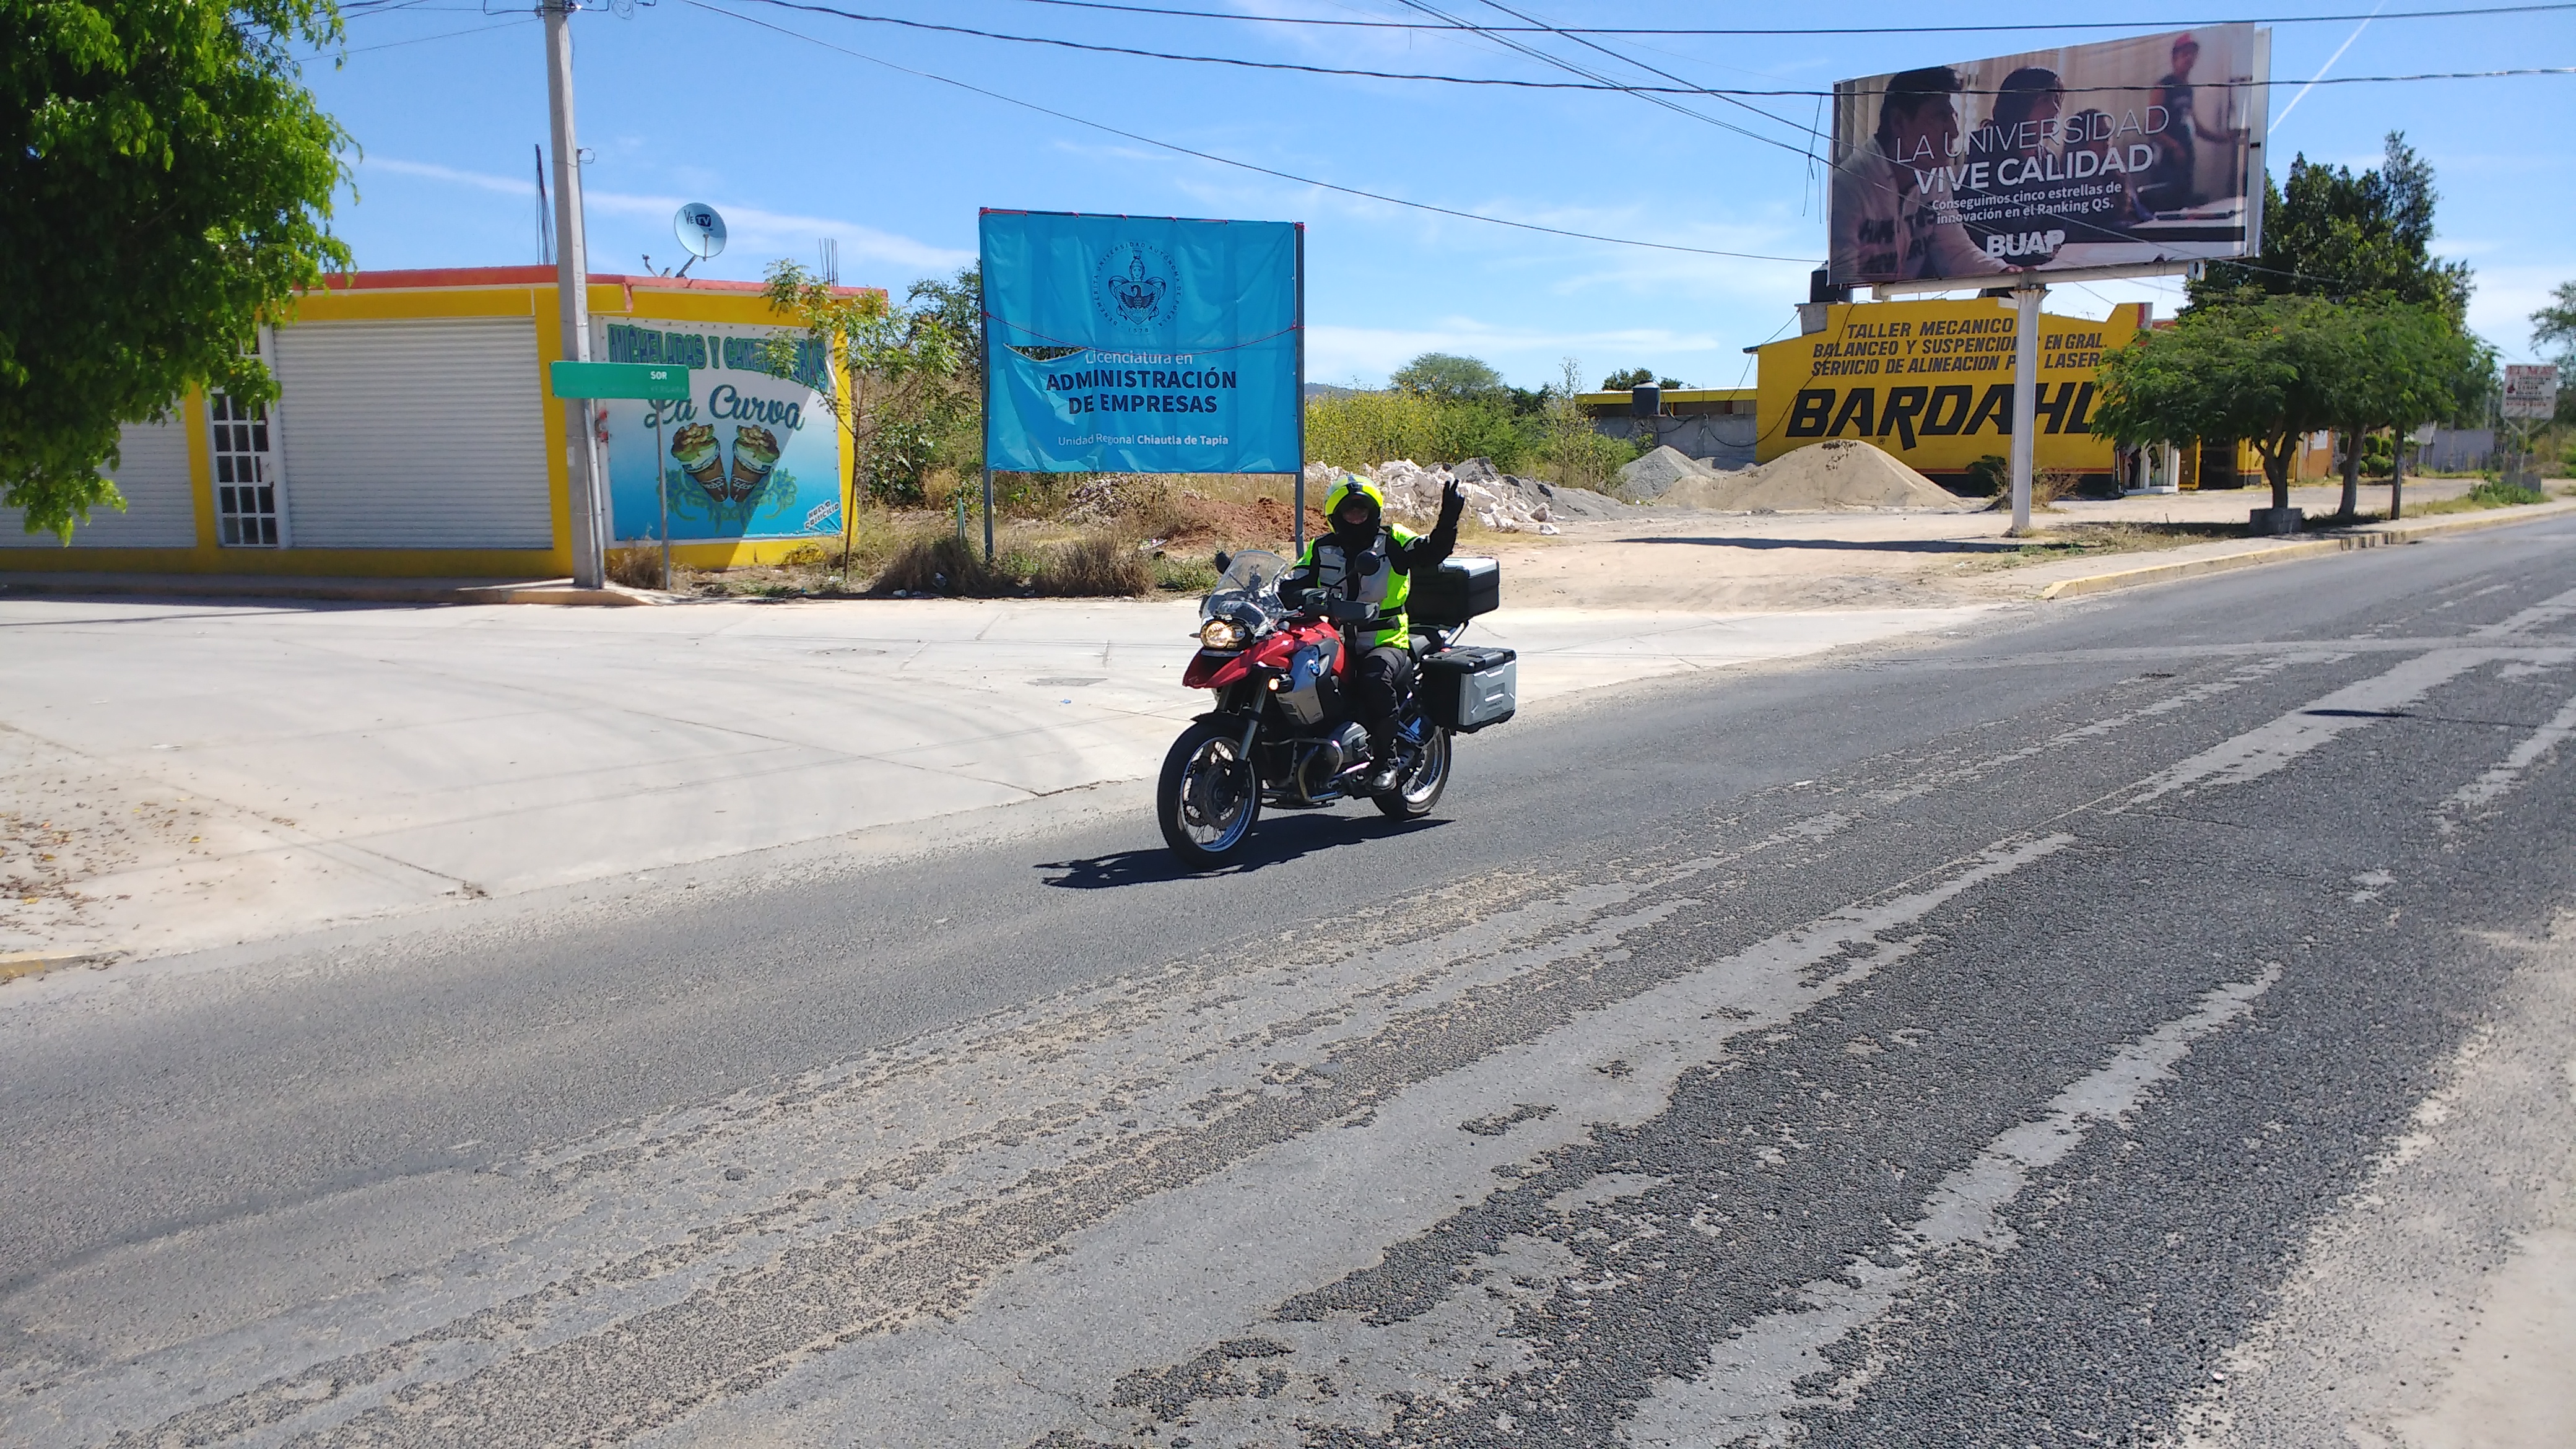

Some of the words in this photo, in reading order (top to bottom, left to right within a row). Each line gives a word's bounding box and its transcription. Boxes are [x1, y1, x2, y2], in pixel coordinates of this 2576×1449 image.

[1897, 134, 1934, 163] LA
[1945, 105, 2169, 159] UNIVERSIDAD
[1914, 162, 1990, 194] VIVE
[1997, 144, 2154, 186] CALIDAD
[1932, 194, 2010, 211] Conseguimos
[2013, 191, 2045, 203] cinco
[2048, 185, 2103, 199] estrellas
[2106, 181, 2122, 194] de
[1937, 208, 2002, 225] innovación
[2005, 209, 2020, 220] en
[2023, 203, 2034, 217] el
[2037, 199, 2089, 215] Ranking
[2092, 198, 2114, 211] QS.
[1986, 229, 2066, 259] BUAP
[1847, 322, 1912, 339] TALLER
[1920, 318, 2014, 336] MECANICO
[708, 335, 720, 369] Y
[1086, 350, 1172, 365] Licenciatura
[1175, 354, 1193, 365] en
[1813, 340, 1899, 359] BALANCEO
[1906, 340, 1917, 355] Y
[2045, 334, 2063, 350] EN
[2065, 333, 2107, 350] GRAL.
[650, 371, 668, 380] SOR
[1812, 359, 1879, 376] SERVICIO
[1886, 358, 1904, 374] DE
[1907, 355, 1998, 373] ALINEACION
[2044, 352, 2101, 369] LASER
[1046, 367, 1237, 391] ADMINISTRACIÓN
[708, 383, 806, 432] Curva
[1068, 394, 1094, 415] DE
[1100, 393, 1217, 413] EMPRESAS
[1785, 381, 2099, 451] BARDAHL
[1058, 434, 1094, 446] Unidad
[1095, 433, 1135, 446] Regional
[1137, 434, 1181, 445] Chiautla
[1184, 435, 1198, 445] de
[1200, 435, 1229, 447] Tapia
